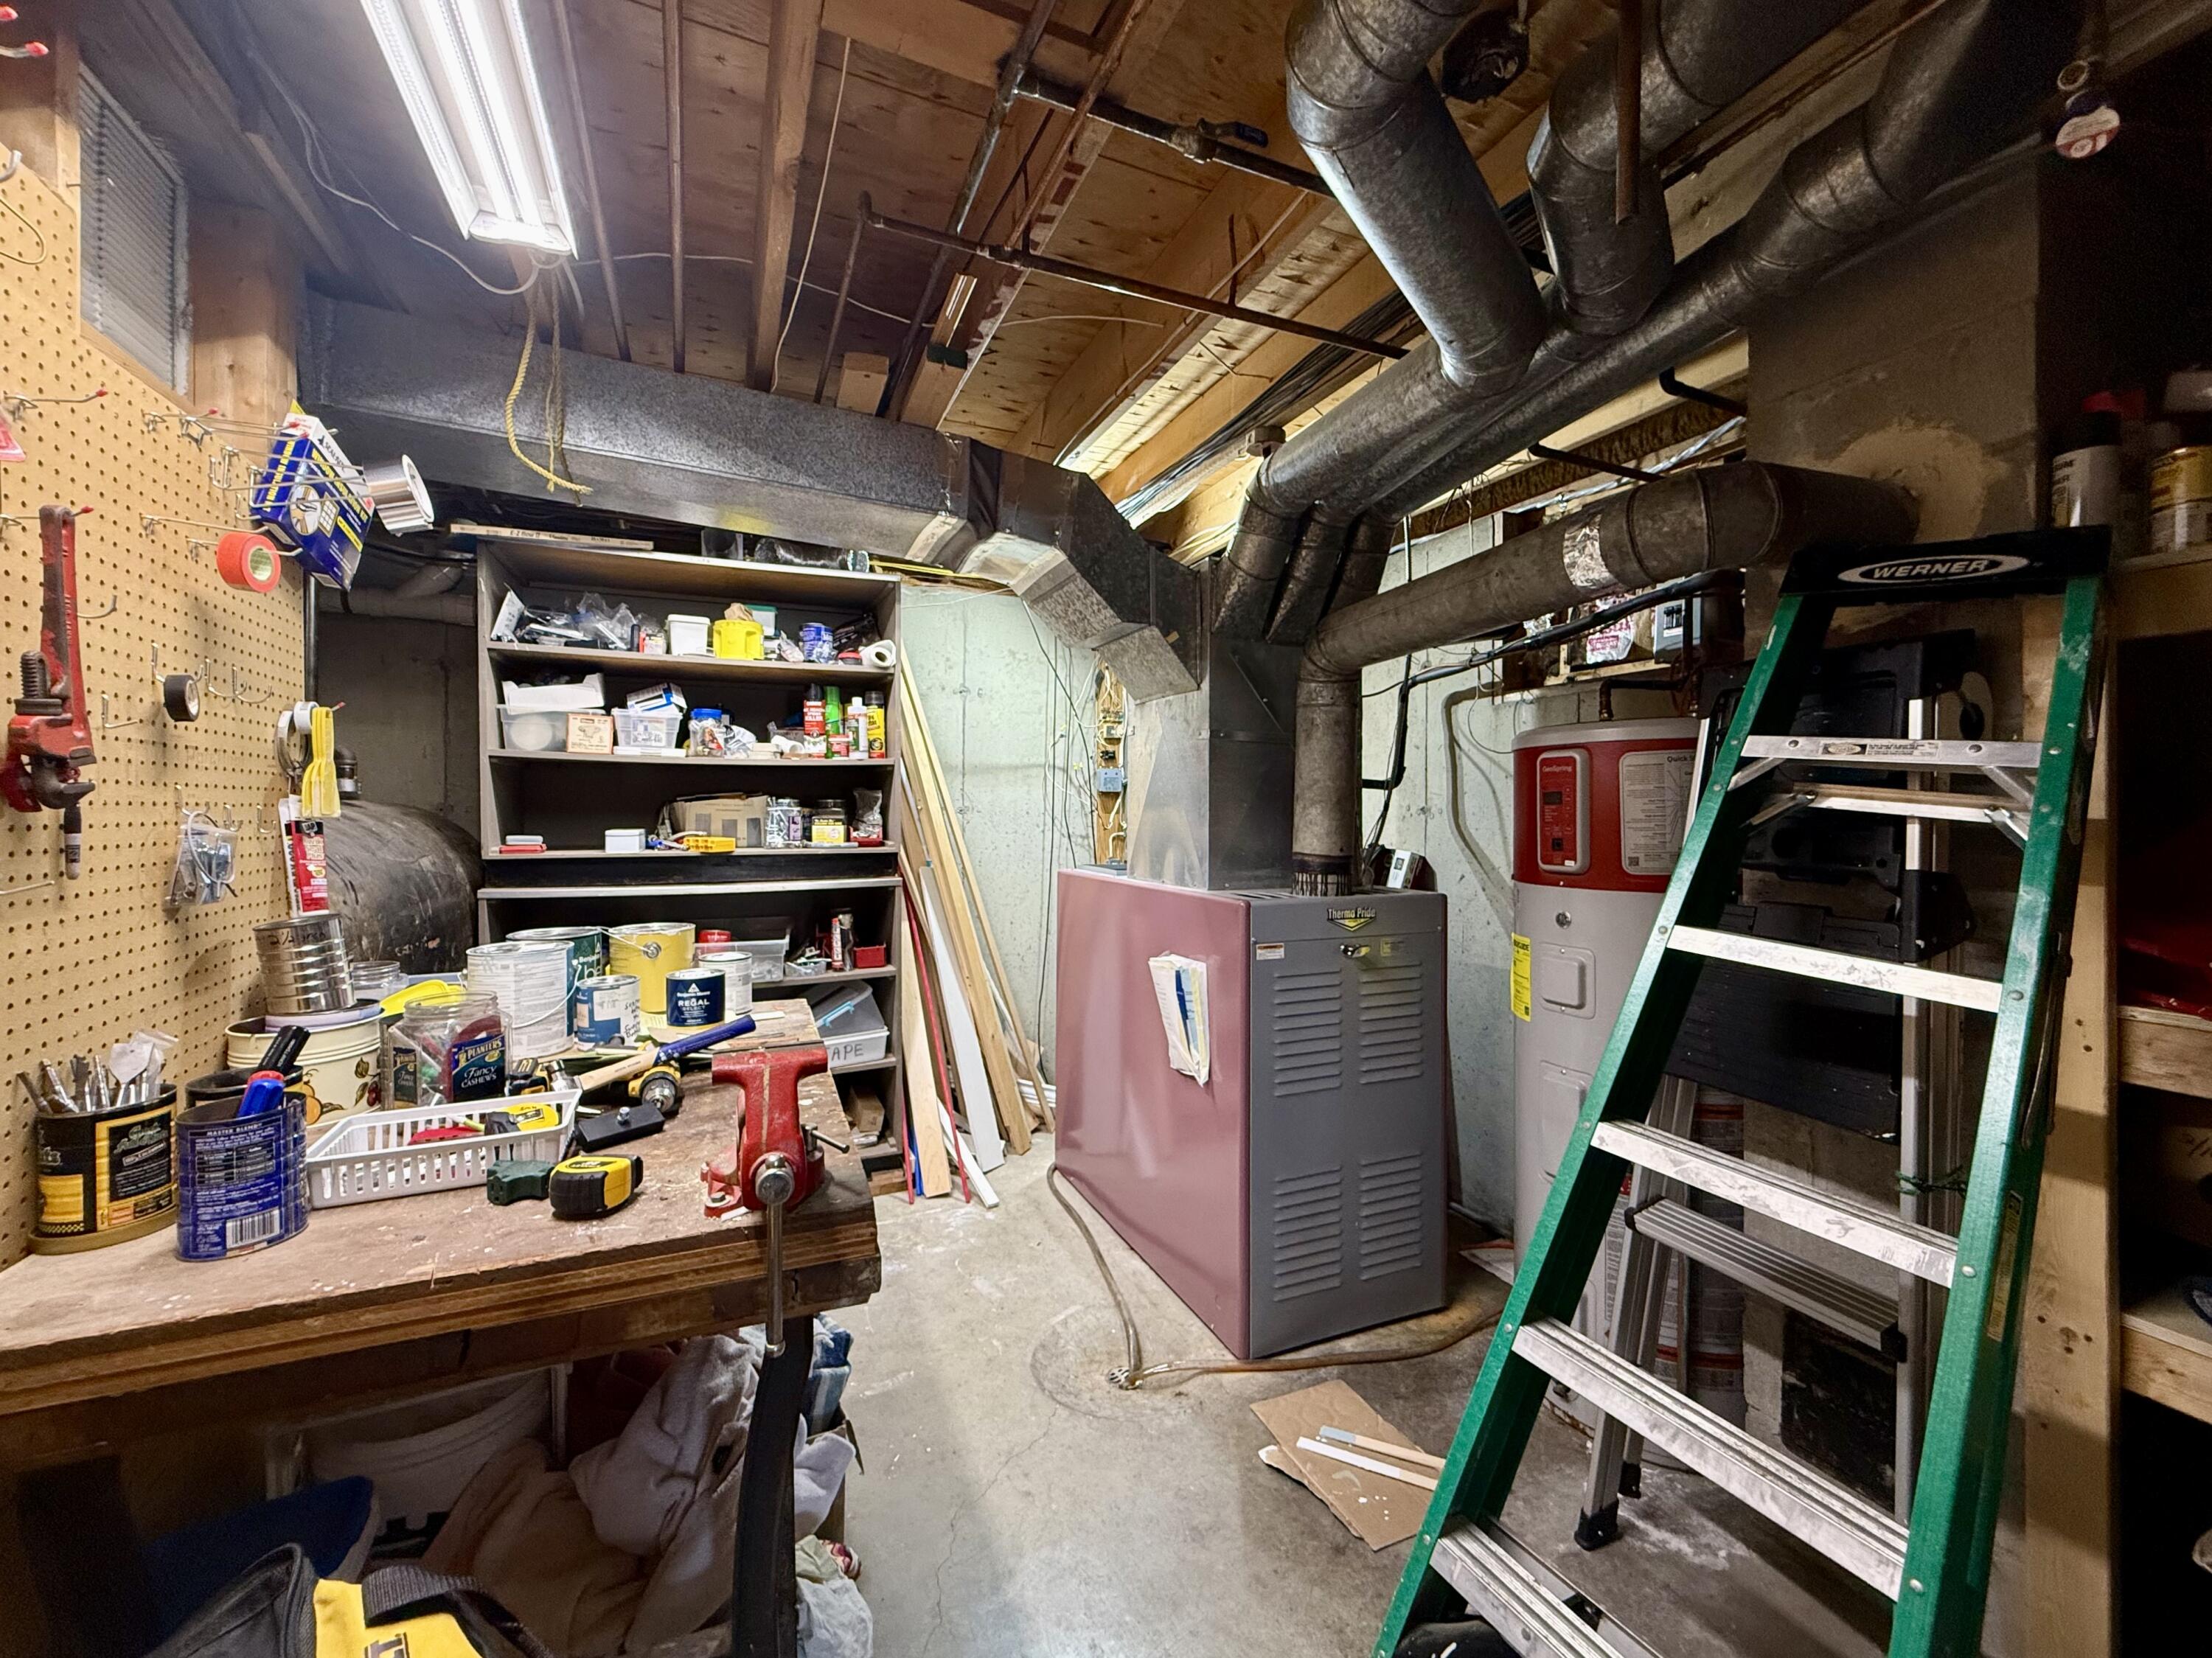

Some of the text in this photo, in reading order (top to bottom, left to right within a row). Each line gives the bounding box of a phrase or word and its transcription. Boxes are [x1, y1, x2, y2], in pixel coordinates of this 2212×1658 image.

[1873, 559, 1989, 579] WERNER
[1666, 755, 1688, 763] Quick
[1328, 907, 1376, 919] Thermo Pride
[678, 998, 710, 1007] REGAL
[467, 1038, 502, 1059] PLANTERS
[826, 1043, 864, 1061] APE
[465, 1065, 497, 1078] Fancy
[206, 1127, 234, 1136] MASTER
